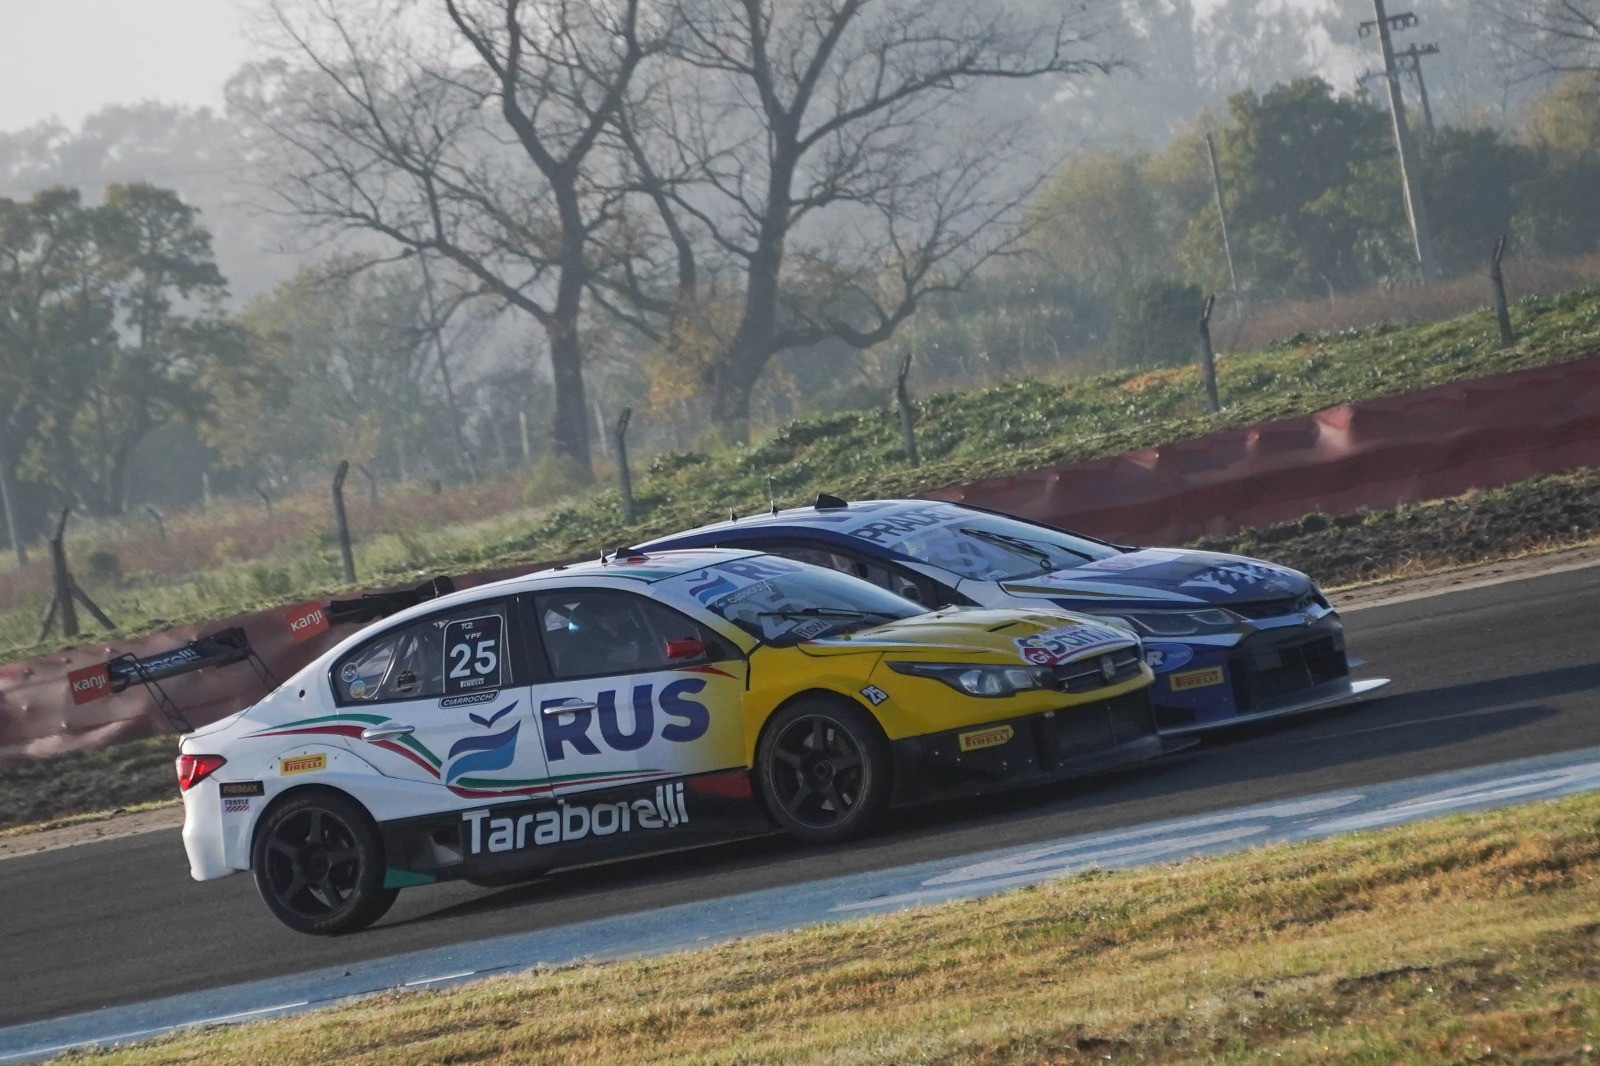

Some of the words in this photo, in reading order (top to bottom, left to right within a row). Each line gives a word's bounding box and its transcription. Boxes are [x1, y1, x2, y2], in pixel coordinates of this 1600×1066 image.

[290, 609, 323, 632] kanji
[465, 632, 482, 640] YPF
[449, 639, 497, 679] 25
[72, 671, 106, 693] kanji
[1174, 669, 1220, 690] PIRELLI
[444, 693, 494, 707] CIARROCCHI
[861, 687, 888, 706] 25
[540, 677, 711, 763] RUS
[964, 730, 1010, 750] PIRELLI
[283, 755, 323, 773] PIRELLI
[461, 782, 690, 855] Taraborelli
